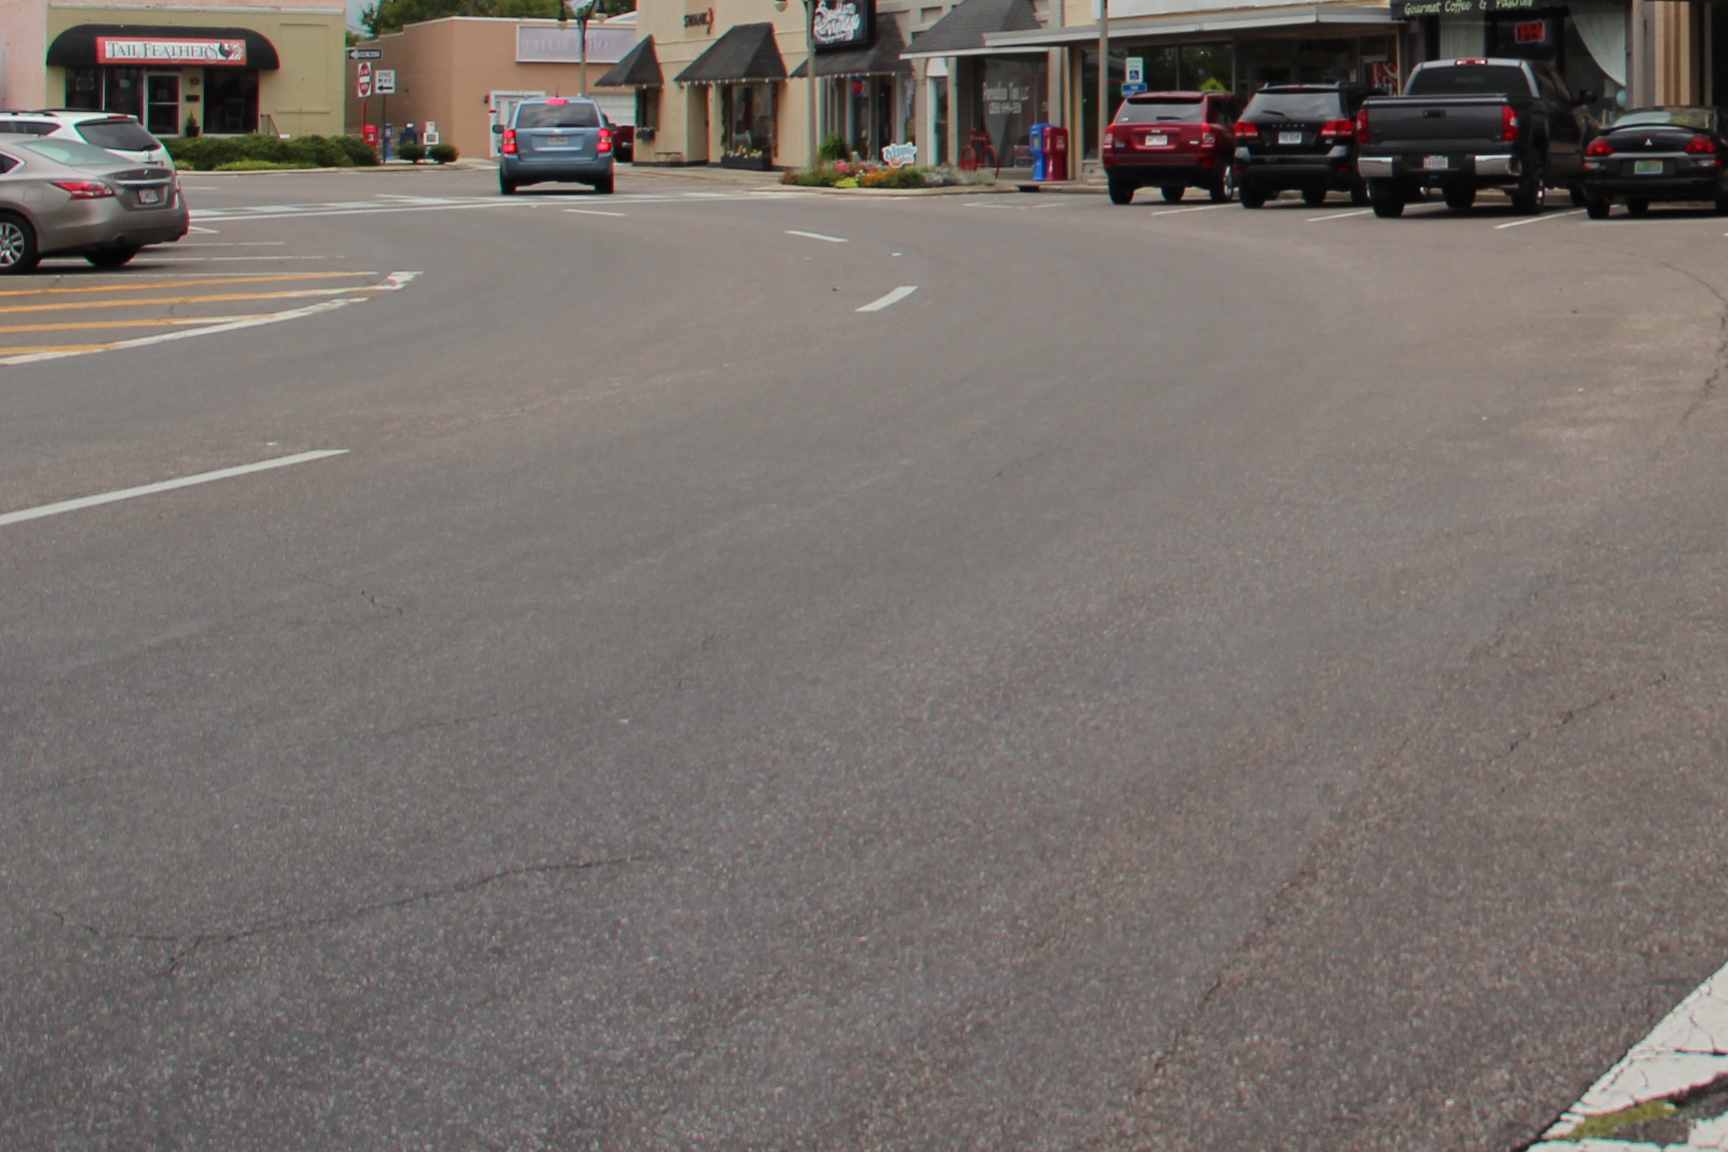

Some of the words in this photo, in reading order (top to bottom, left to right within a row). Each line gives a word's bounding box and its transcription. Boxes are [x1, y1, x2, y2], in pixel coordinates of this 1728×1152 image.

[1404, 1, 1442, 16] Gourmet
[107, 41, 140, 57] TAIL
[141, 42, 218, 62] FEATHERS
